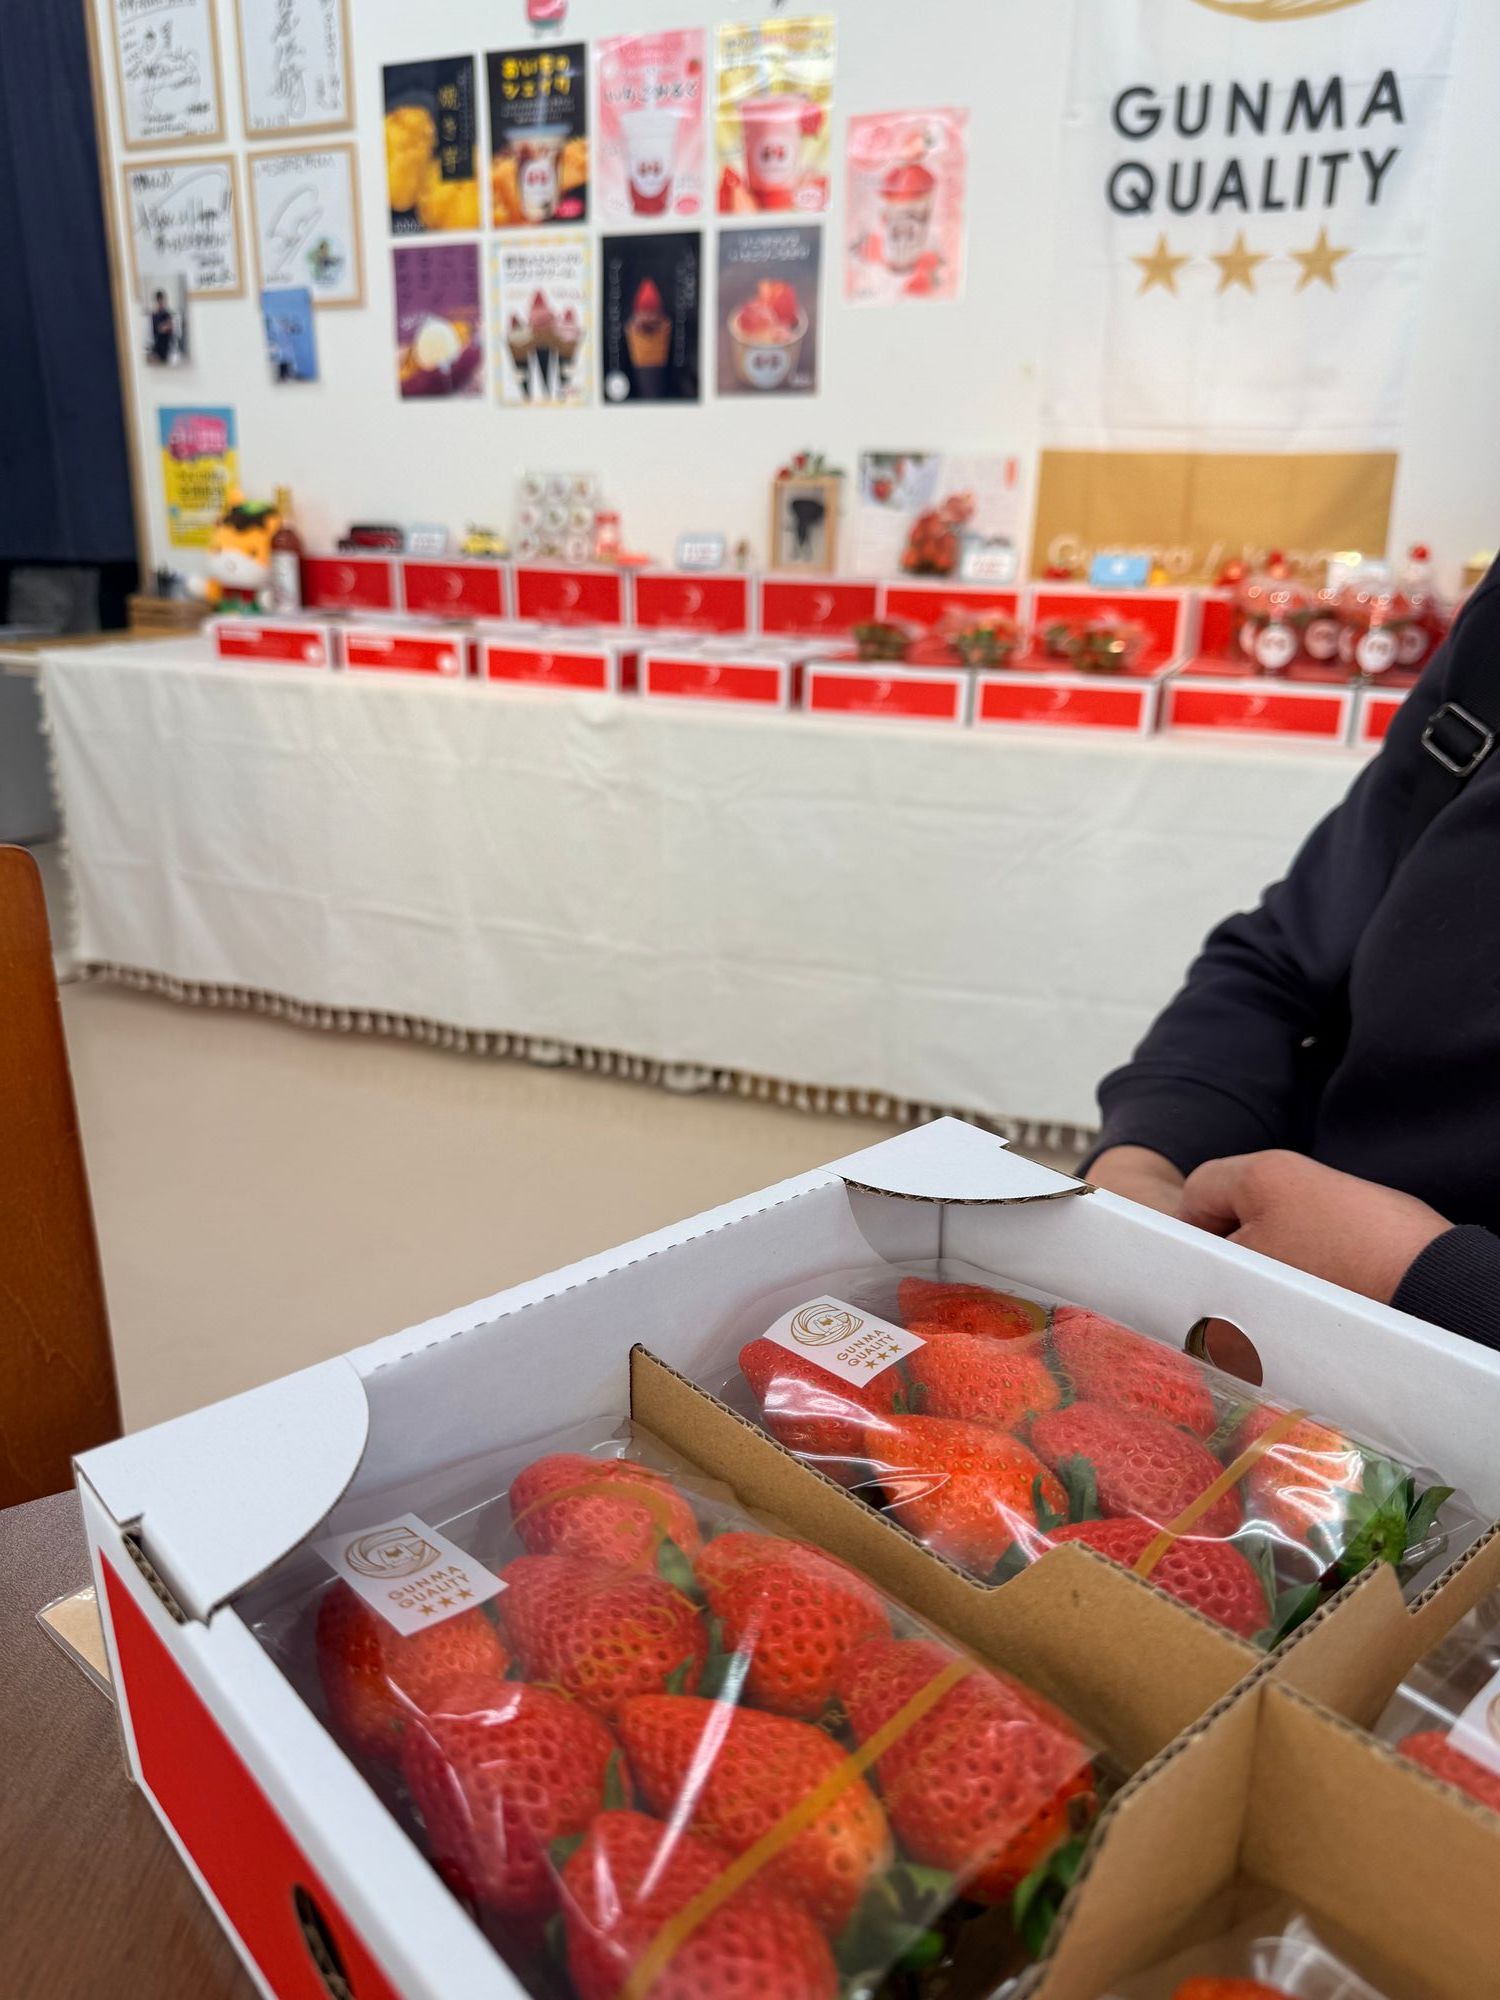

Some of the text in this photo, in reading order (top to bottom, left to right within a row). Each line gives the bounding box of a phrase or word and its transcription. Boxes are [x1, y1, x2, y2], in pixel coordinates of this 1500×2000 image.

[1111, 69, 1405, 140] GUNMA
[1106, 146, 1403, 217] QUALITY
[837, 1330, 885, 1361] GUNMA
[847, 1335, 895, 1366] QUALITY
[388, 1566, 461, 1600] GUNMA
[399, 1574, 470, 1608] QUALITY
